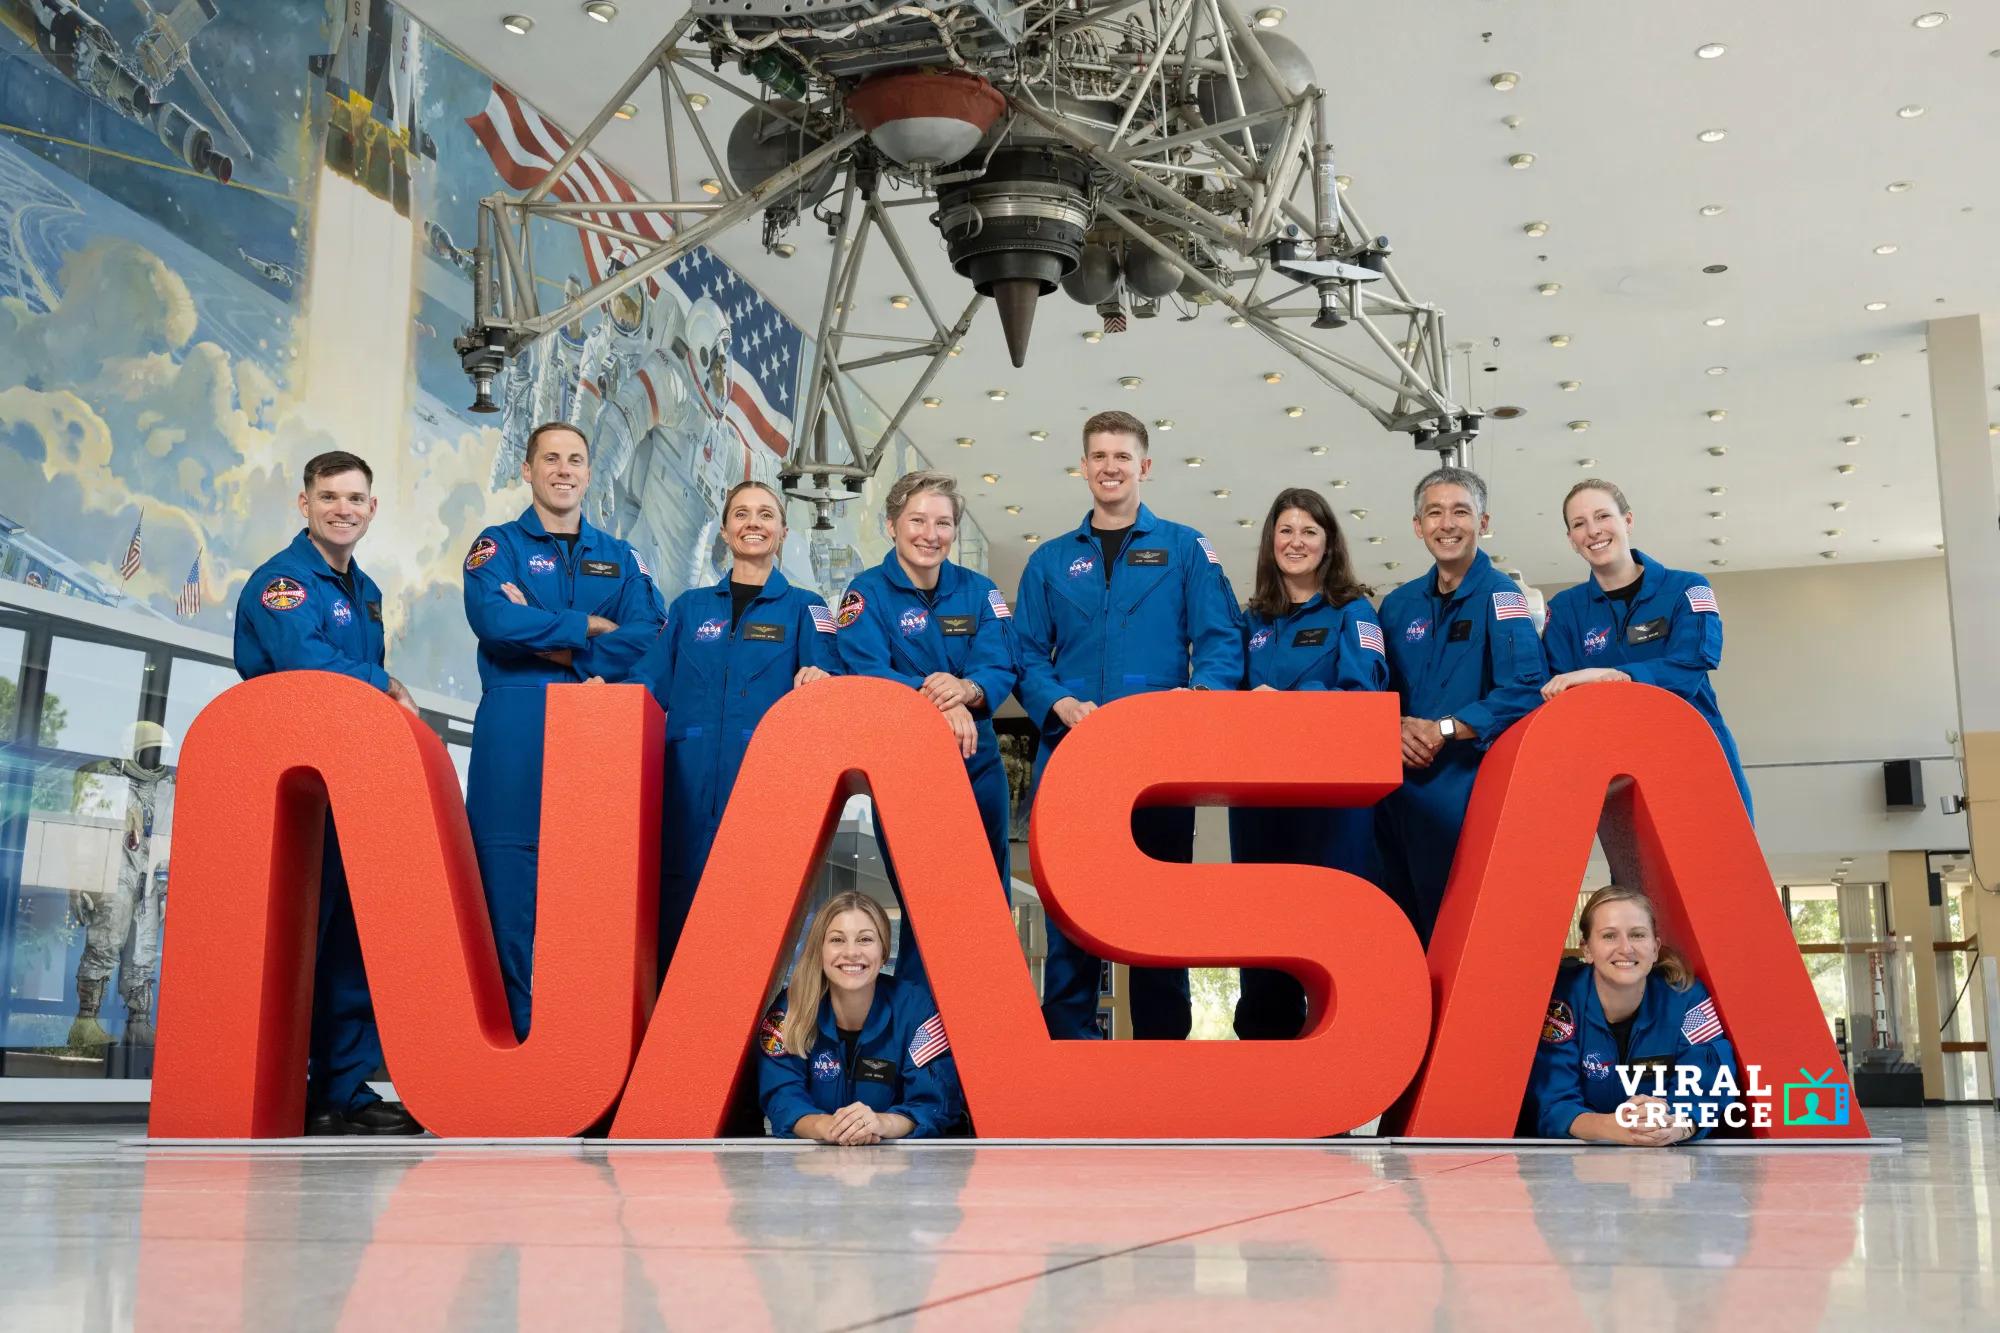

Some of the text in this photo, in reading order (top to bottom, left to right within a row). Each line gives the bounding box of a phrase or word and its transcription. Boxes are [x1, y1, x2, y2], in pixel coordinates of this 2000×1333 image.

[399, 16, 410, 73] USA
[529, 559, 555, 568] NASA
[1069, 561, 1093, 571] NASA
[333, 607, 351, 617] NASA
[901, 616, 927, 627] NASA
[1584, 636, 1606, 647] NASA
[149, 671, 1870, 1138] NASA
[814, 1061, 841, 1070] NASA
[1582, 1060, 1610, 1074] NASA
